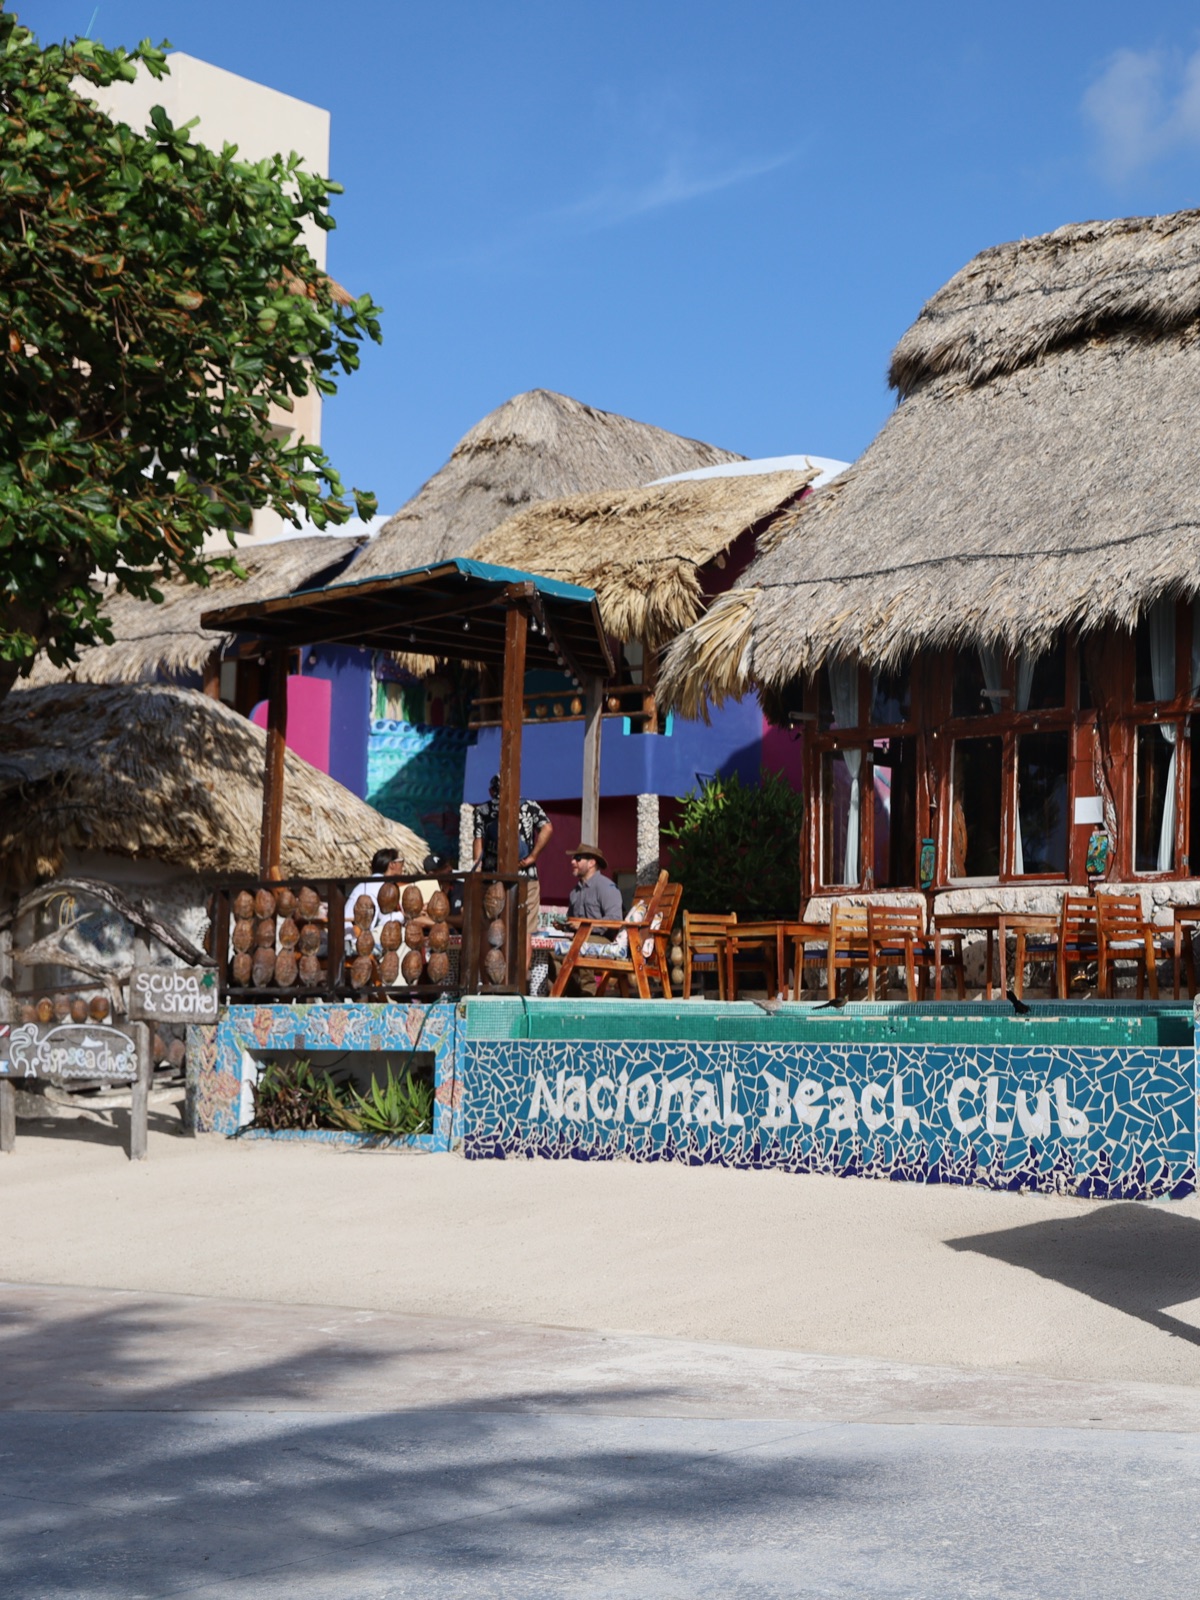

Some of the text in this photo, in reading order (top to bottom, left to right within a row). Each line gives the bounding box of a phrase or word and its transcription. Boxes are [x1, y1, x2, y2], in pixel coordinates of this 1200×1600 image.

[143, 990, 157, 1012] &
[37, 1041, 95, 1073] Gypsea
[759, 1073, 921, 1132] Beach
